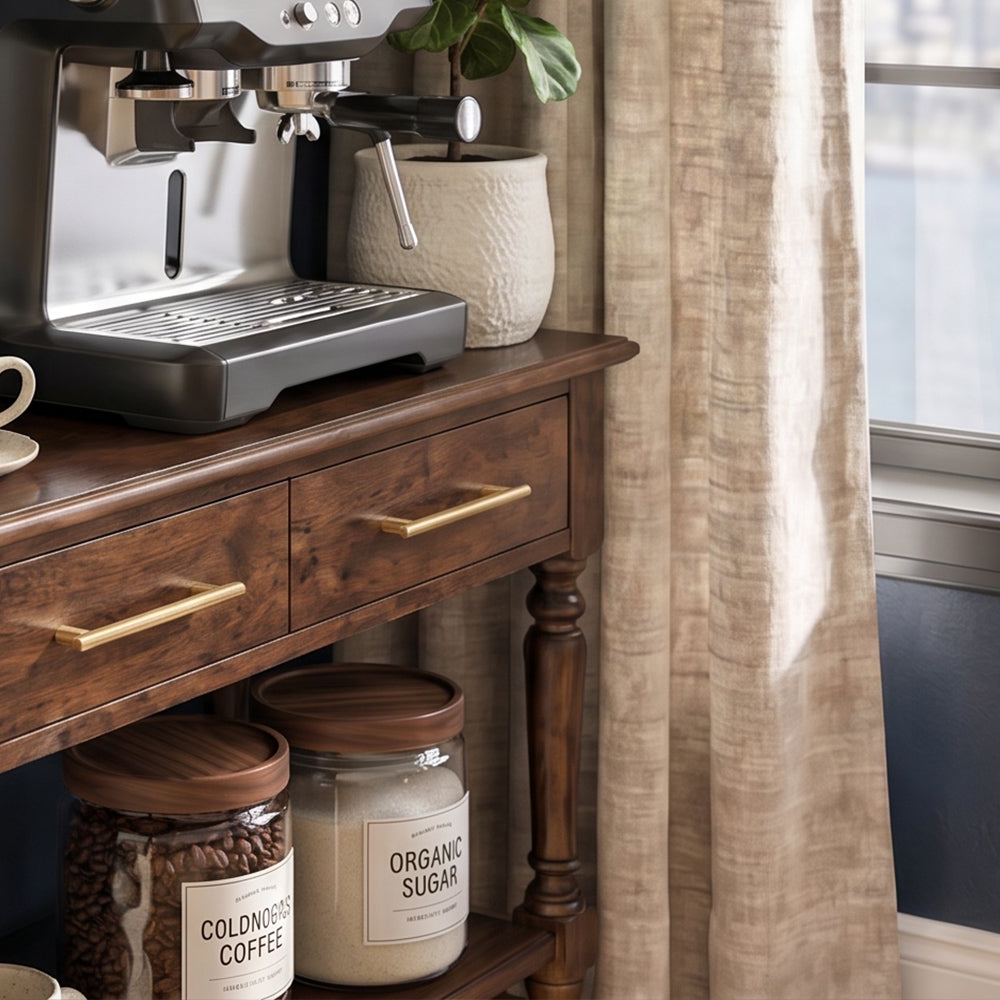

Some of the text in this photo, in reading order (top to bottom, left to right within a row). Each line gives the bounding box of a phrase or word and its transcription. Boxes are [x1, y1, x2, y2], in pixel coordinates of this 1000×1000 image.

[390, 836, 462, 874] ORGANIC
[402, 864, 458, 898] SUGAR
[220, 926, 283, 966] COFFEE
